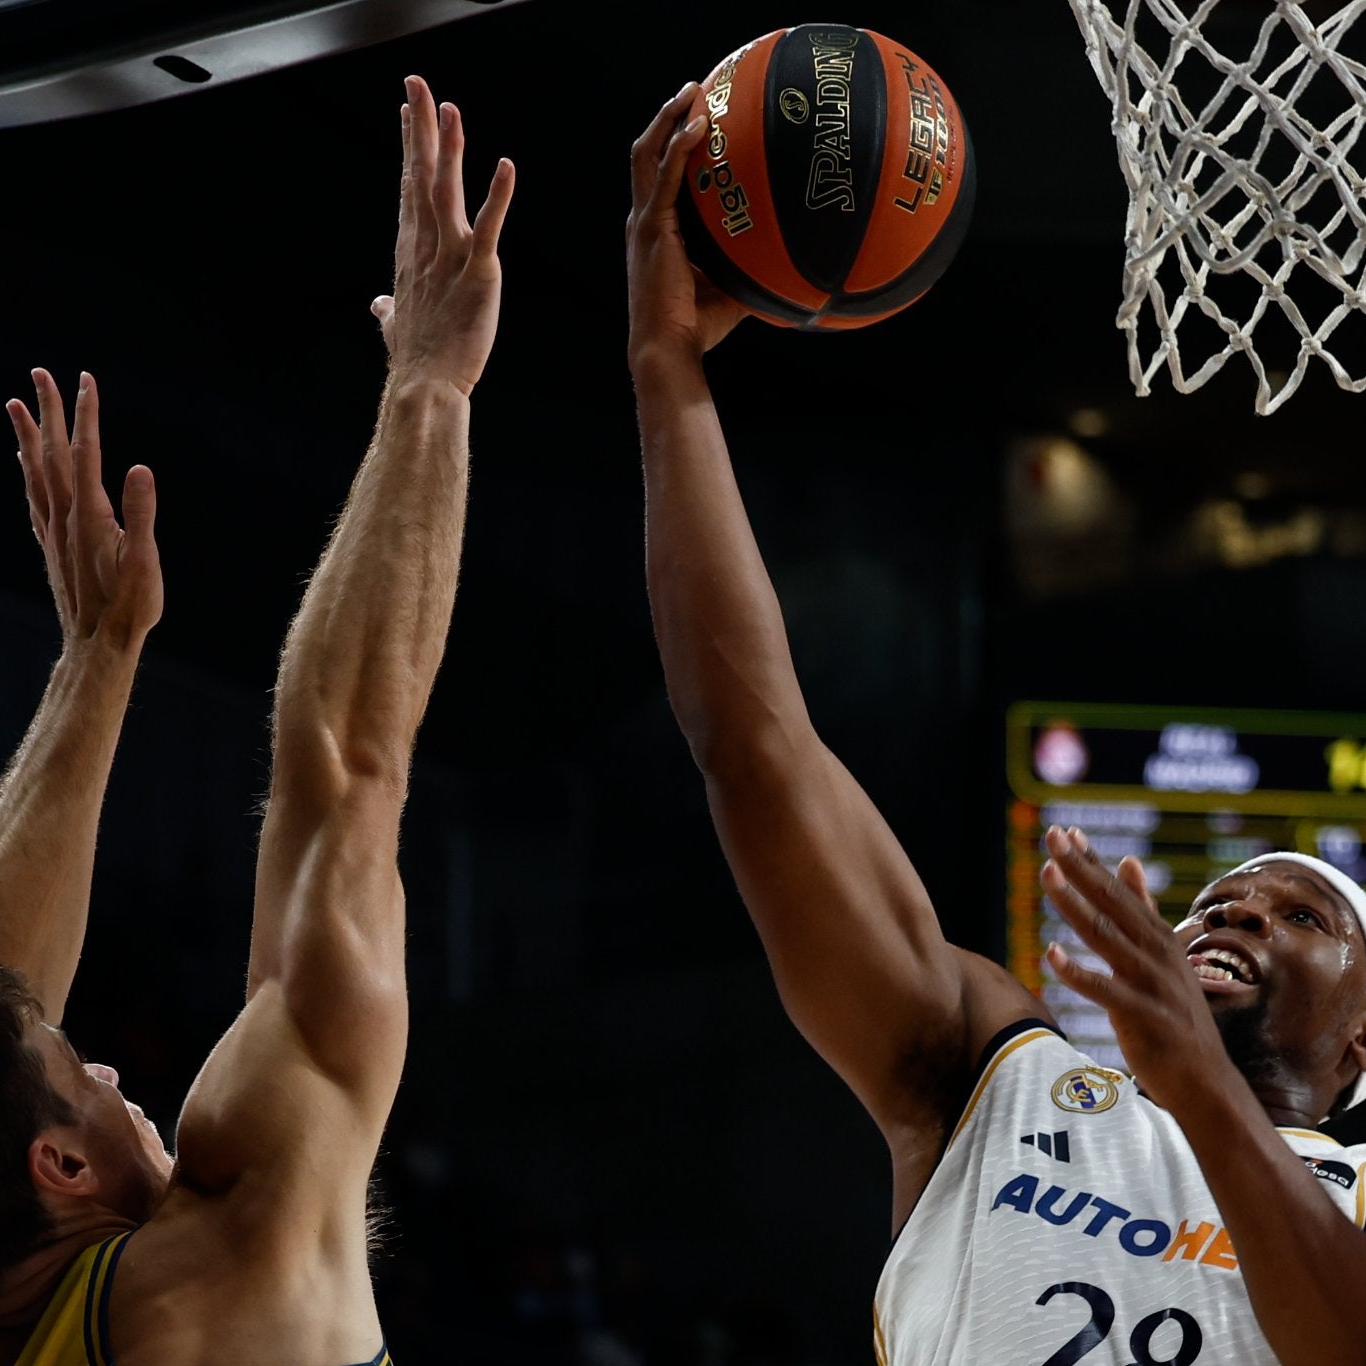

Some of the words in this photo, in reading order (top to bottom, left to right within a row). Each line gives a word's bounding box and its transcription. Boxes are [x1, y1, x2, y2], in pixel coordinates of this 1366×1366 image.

[710, 161, 753, 237] liga
[806, 31, 863, 212] SPALDING
[893, 52, 935, 215] LEGACY
